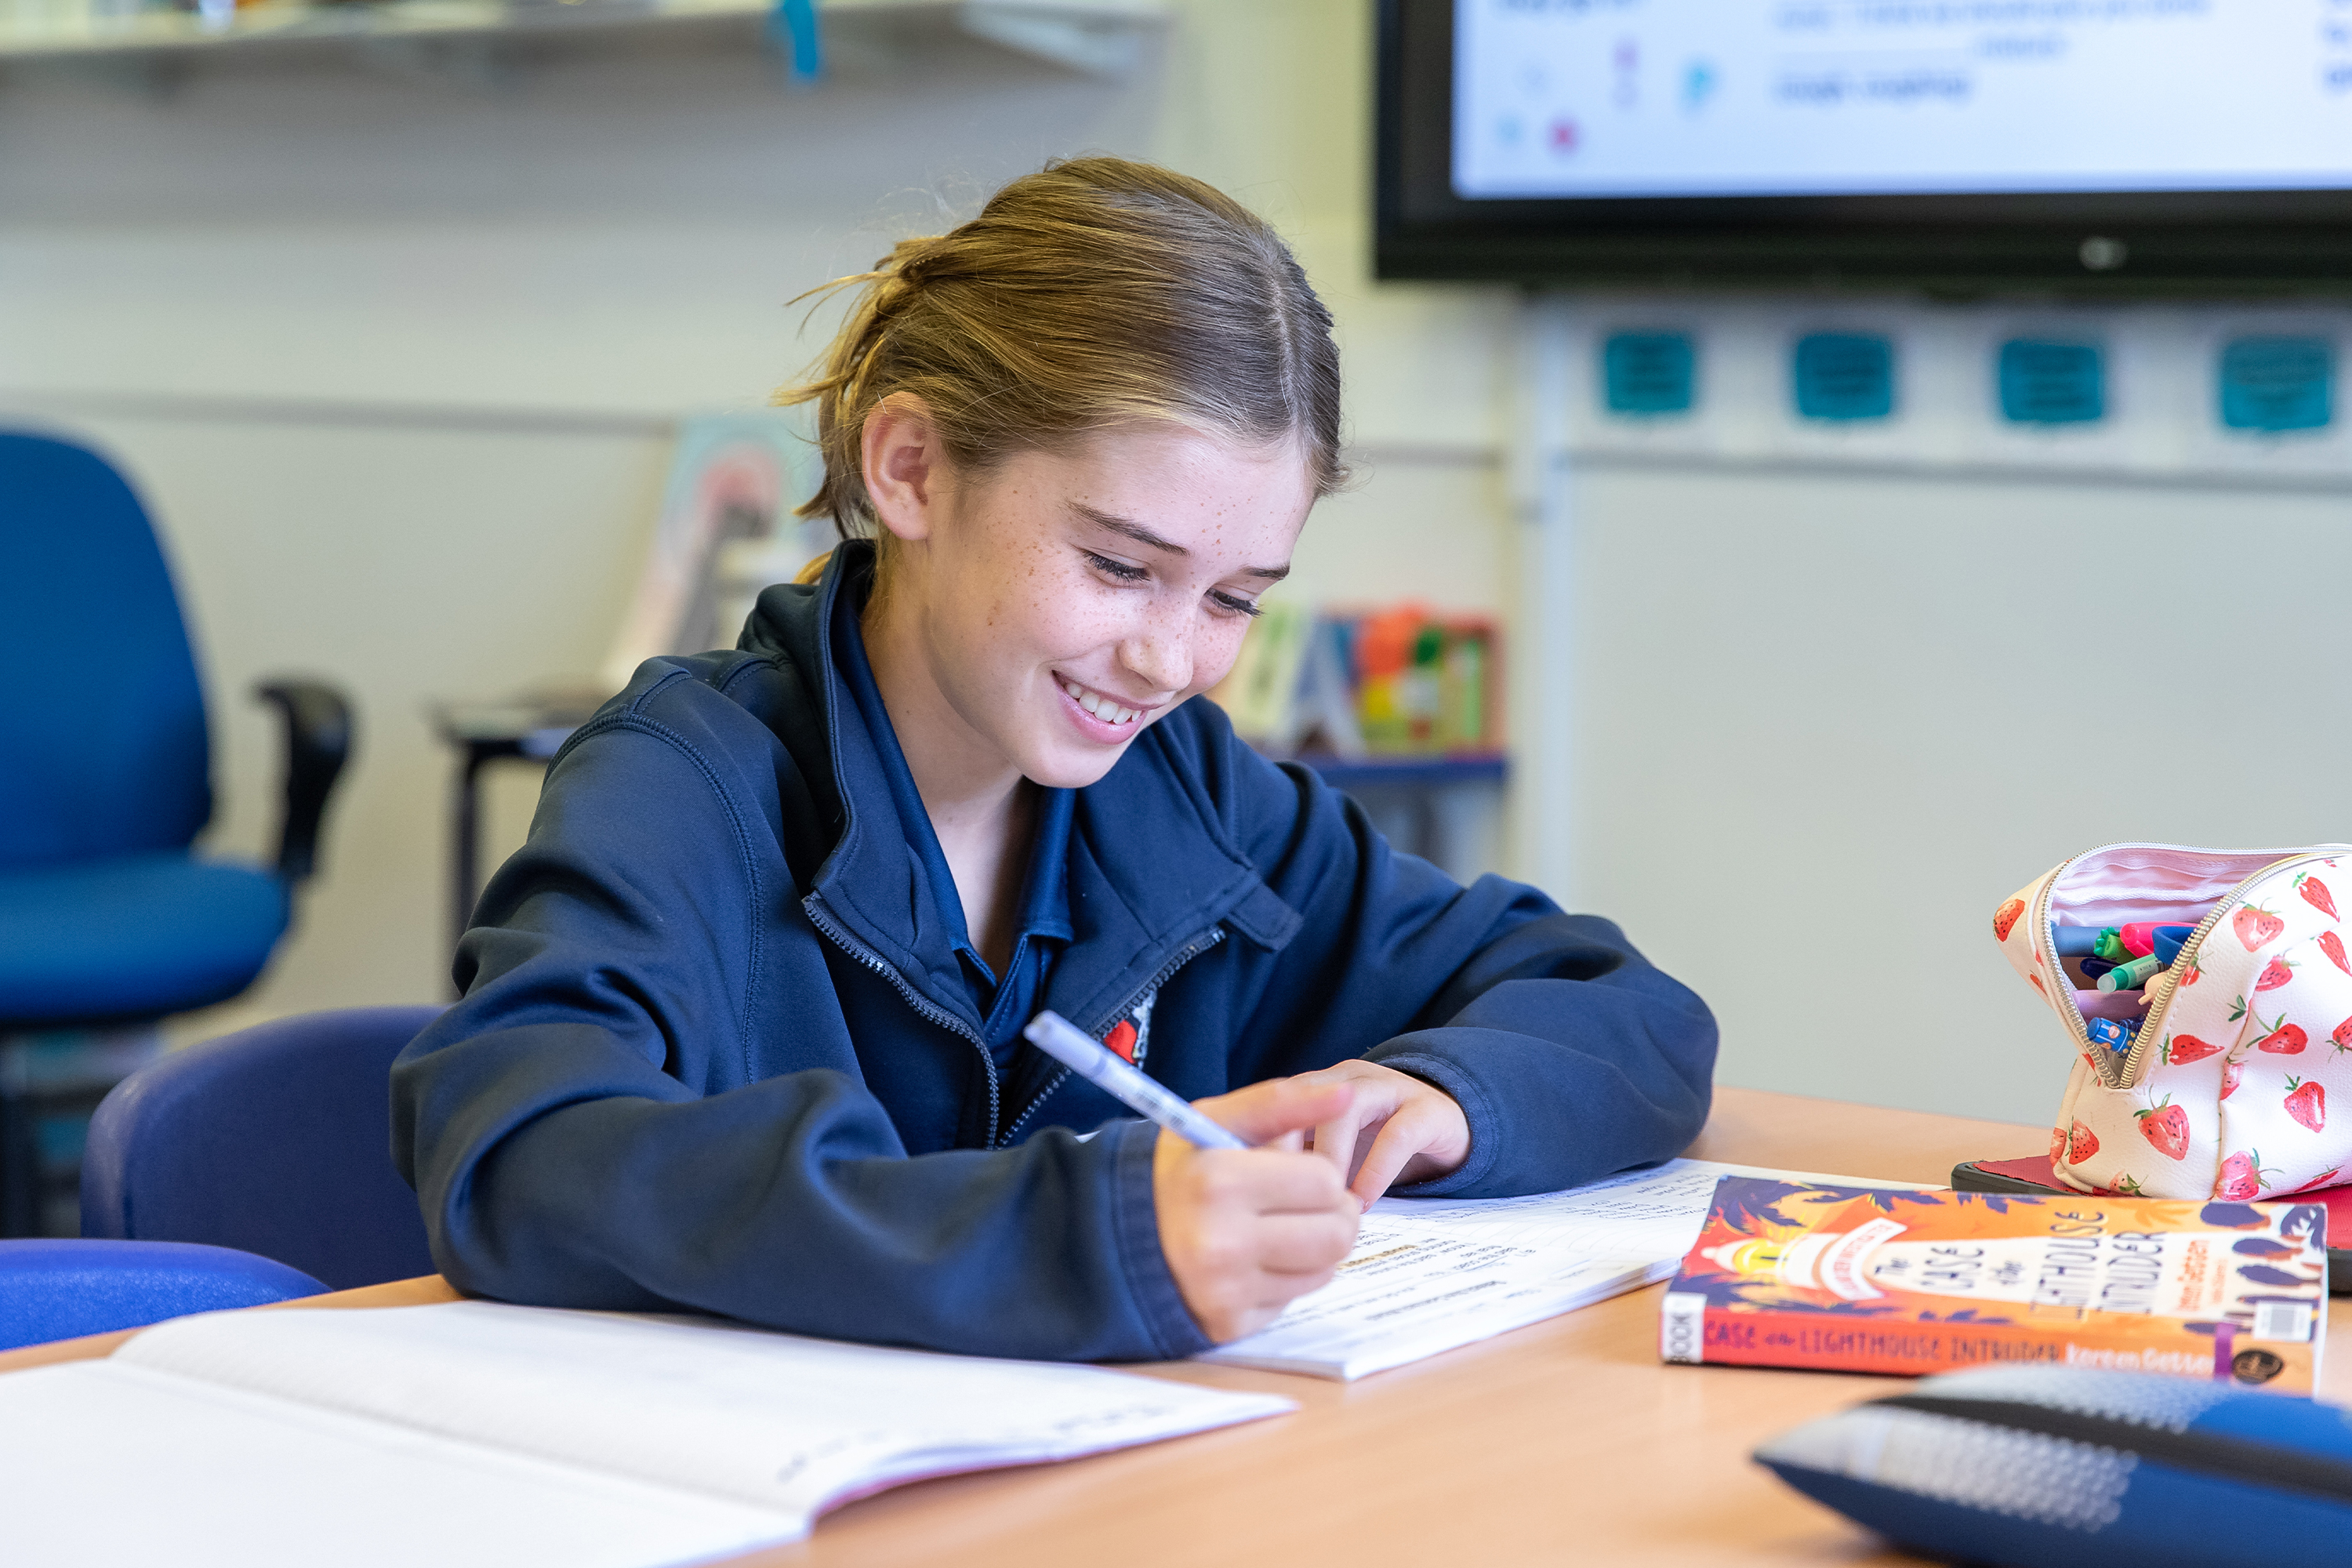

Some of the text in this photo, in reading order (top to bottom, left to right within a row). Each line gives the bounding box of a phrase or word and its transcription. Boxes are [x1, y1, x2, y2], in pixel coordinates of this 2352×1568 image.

[1874, 1257, 1911, 1276] The
[1920, 1247, 1985, 1289] CASE
[1704, 1320, 1756, 1349] CASE
[1799, 1329, 1940, 1361] LIGHTHOUSE
